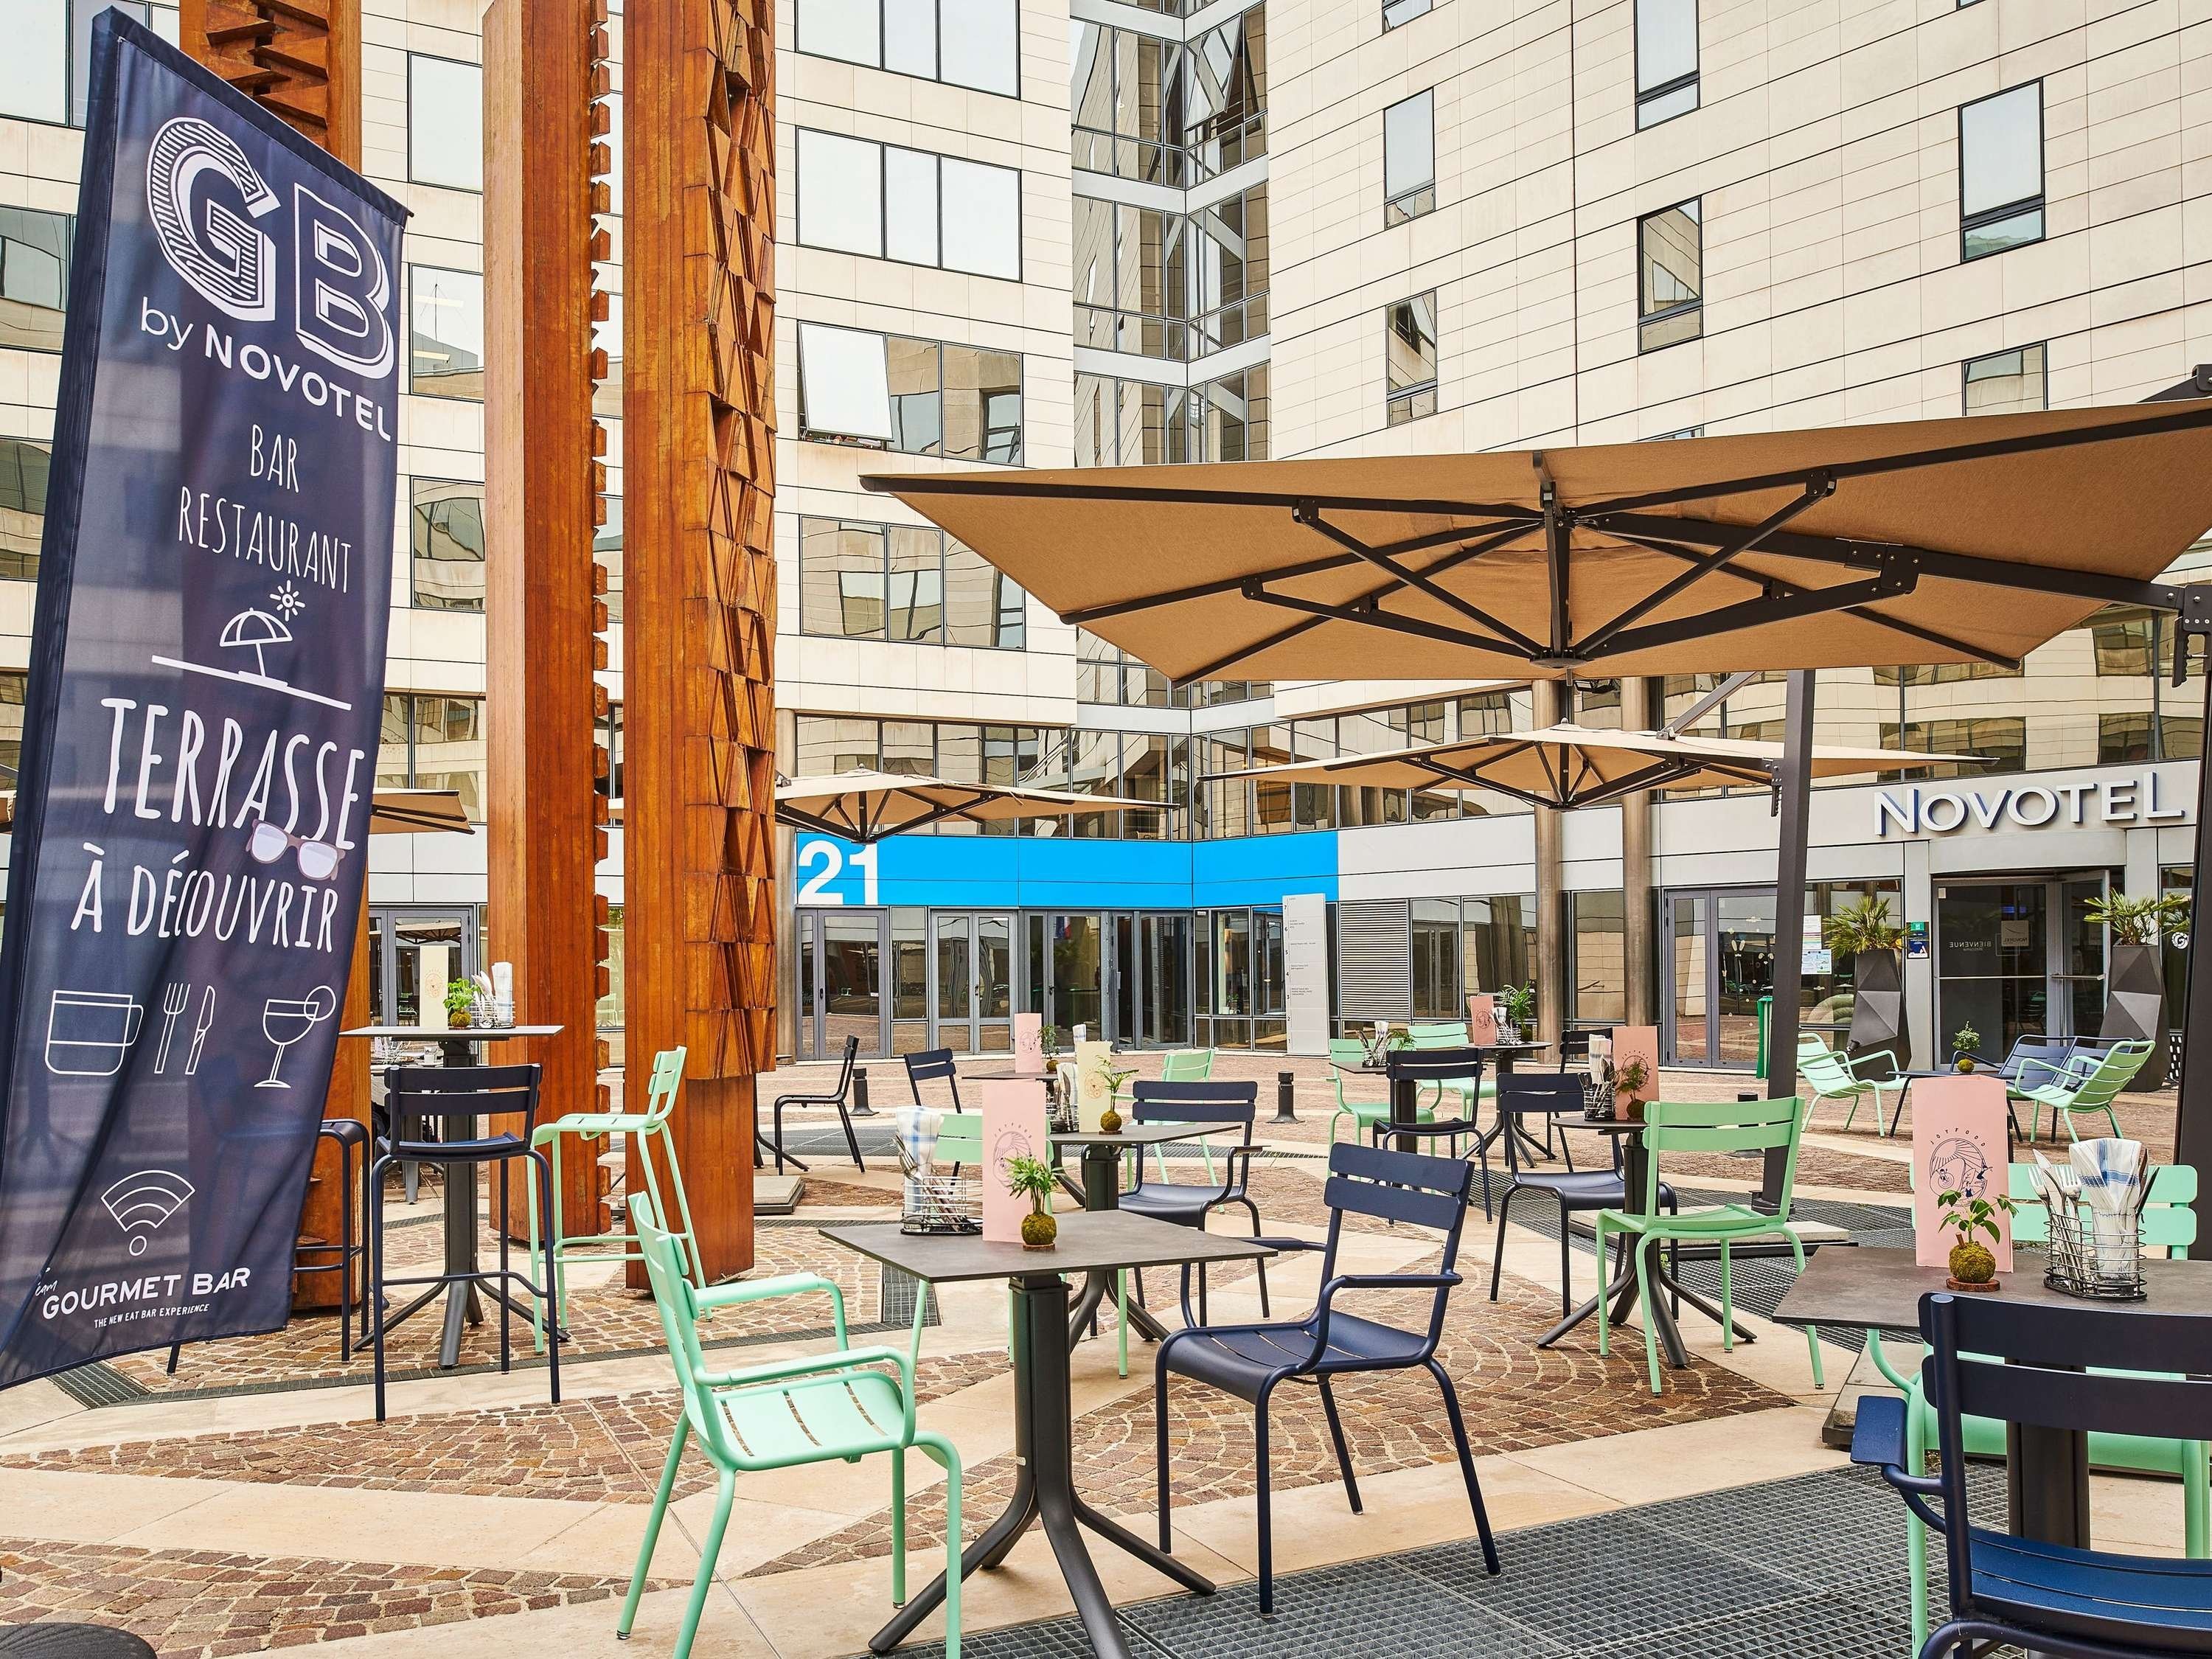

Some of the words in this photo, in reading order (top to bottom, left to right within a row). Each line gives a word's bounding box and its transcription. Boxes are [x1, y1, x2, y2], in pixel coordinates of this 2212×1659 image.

[147, 116, 394, 380] GB
[141, 296, 194, 351] by
[205, 324, 392, 442] NOVOTEL
[251, 424, 299, 493] BAR
[178, 486, 352, 594] RESTAURANT
[101, 698, 365, 850] TERRASSE
[1874, 771, 2185, 835] NOVOTEL
[71, 842, 105, 933] À
[127, 849, 338, 953] DÉCOUVRIR
[798, 840, 878, 905] 21
[1930, 1127, 1986, 1147] JOYFOOD
[43, 1274, 182, 1320] GOURMET
[192, 1267, 251, 1295] BAR
[94, 1317, 108, 1329] THE
[108, 1314, 123, 1325] NEW
[125, 1311, 140, 1321] EAT
[141, 1308, 157, 1319] BAR
[159, 1304, 210, 1317] EXPERIENCE
